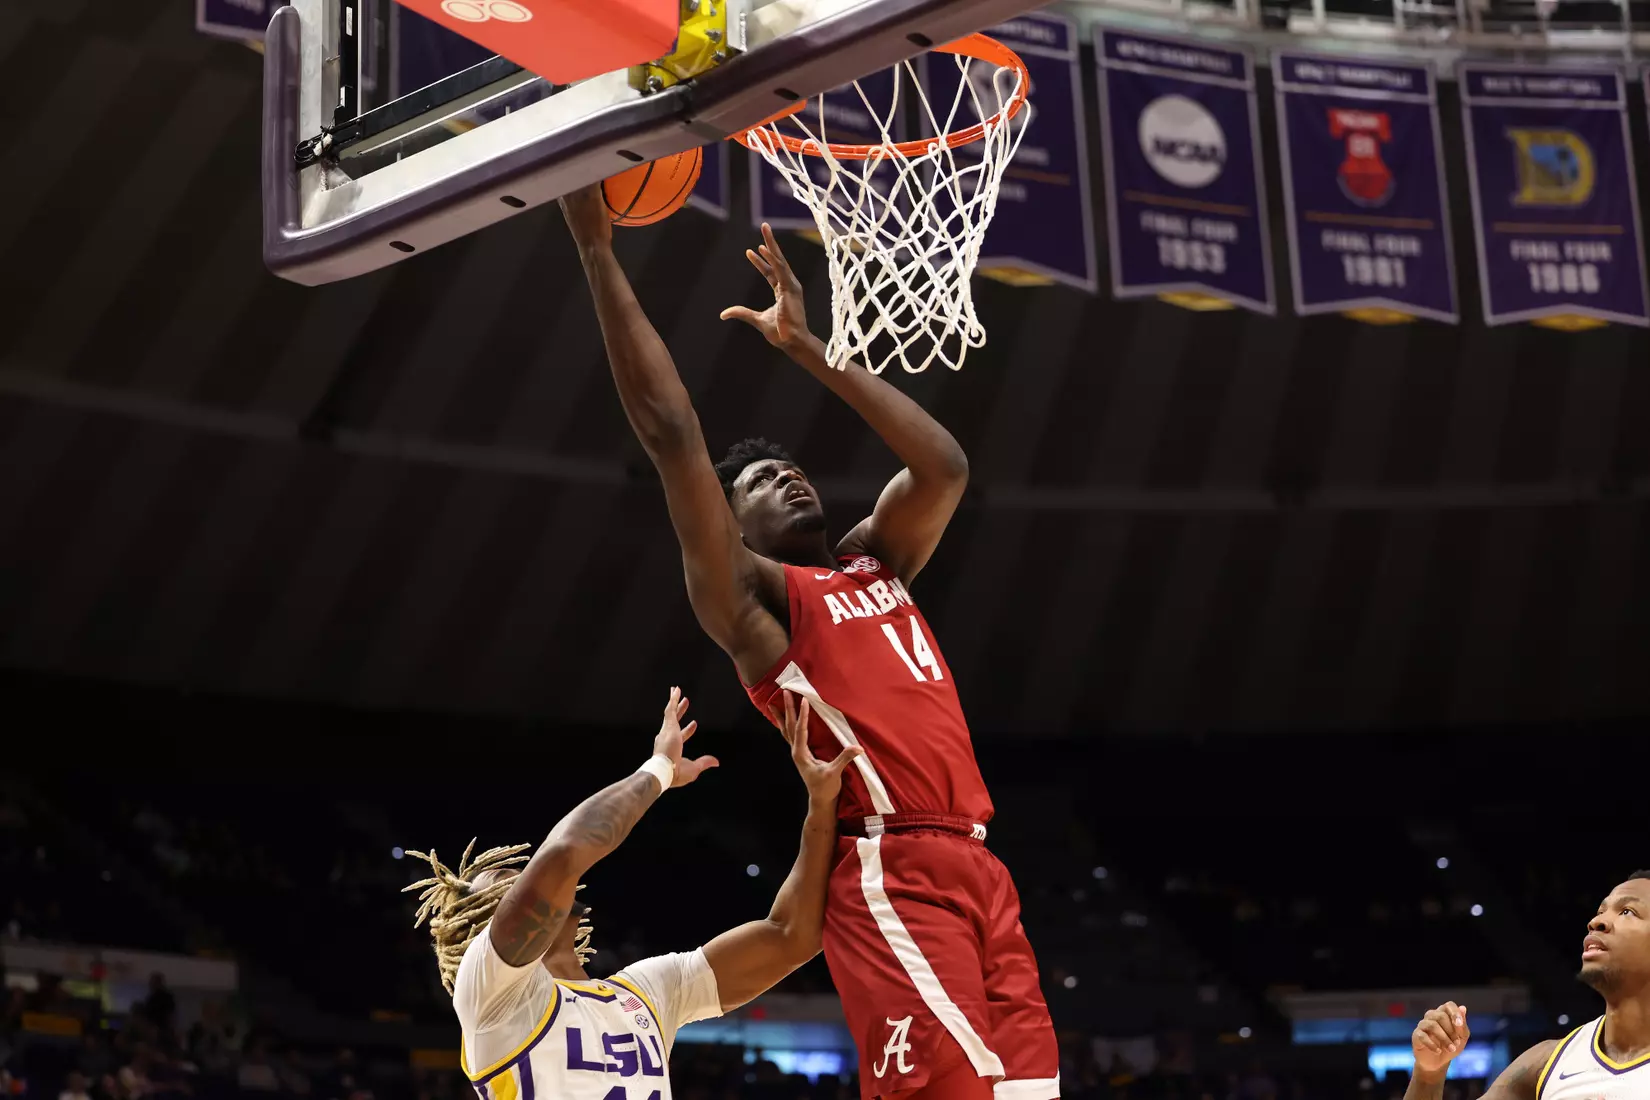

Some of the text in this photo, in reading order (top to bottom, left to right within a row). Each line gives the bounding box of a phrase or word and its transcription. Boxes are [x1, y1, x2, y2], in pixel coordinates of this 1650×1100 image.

[1152, 134, 1222, 167] NCAA
[1139, 210, 1239, 245] FINAL FOUR
[1321, 229, 1422, 257] FINAL FOUR
[1509, 239, 1613, 262] FINAL FOUR
[880, 615, 944, 682] 14
[566, 1025, 664, 1077] LSU
[873, 1015, 915, 1079] A
